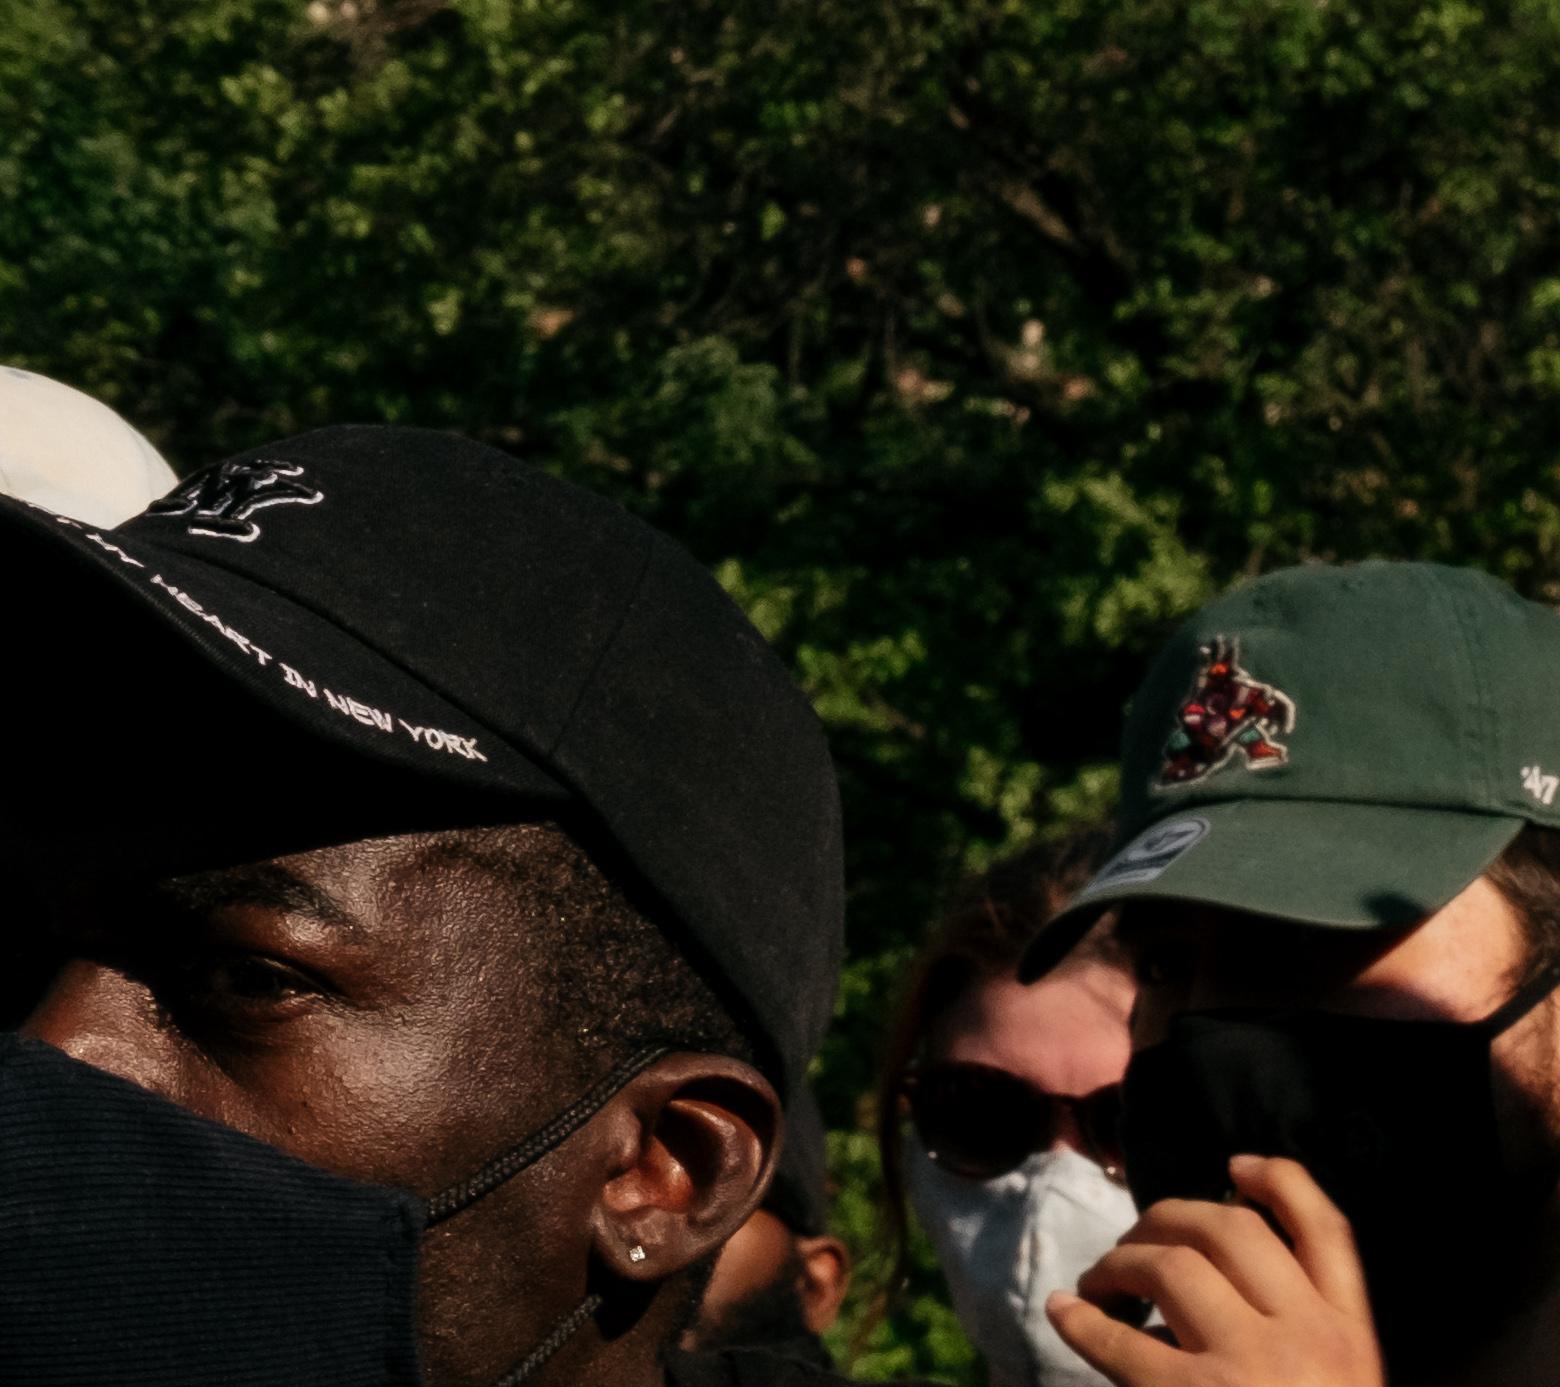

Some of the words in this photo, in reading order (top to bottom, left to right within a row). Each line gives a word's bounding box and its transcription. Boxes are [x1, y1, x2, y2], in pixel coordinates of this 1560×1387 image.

[279, 662, 317, 698] IN
[323, 688, 393, 733] NEW
[399, 718, 488, 762] YORK
